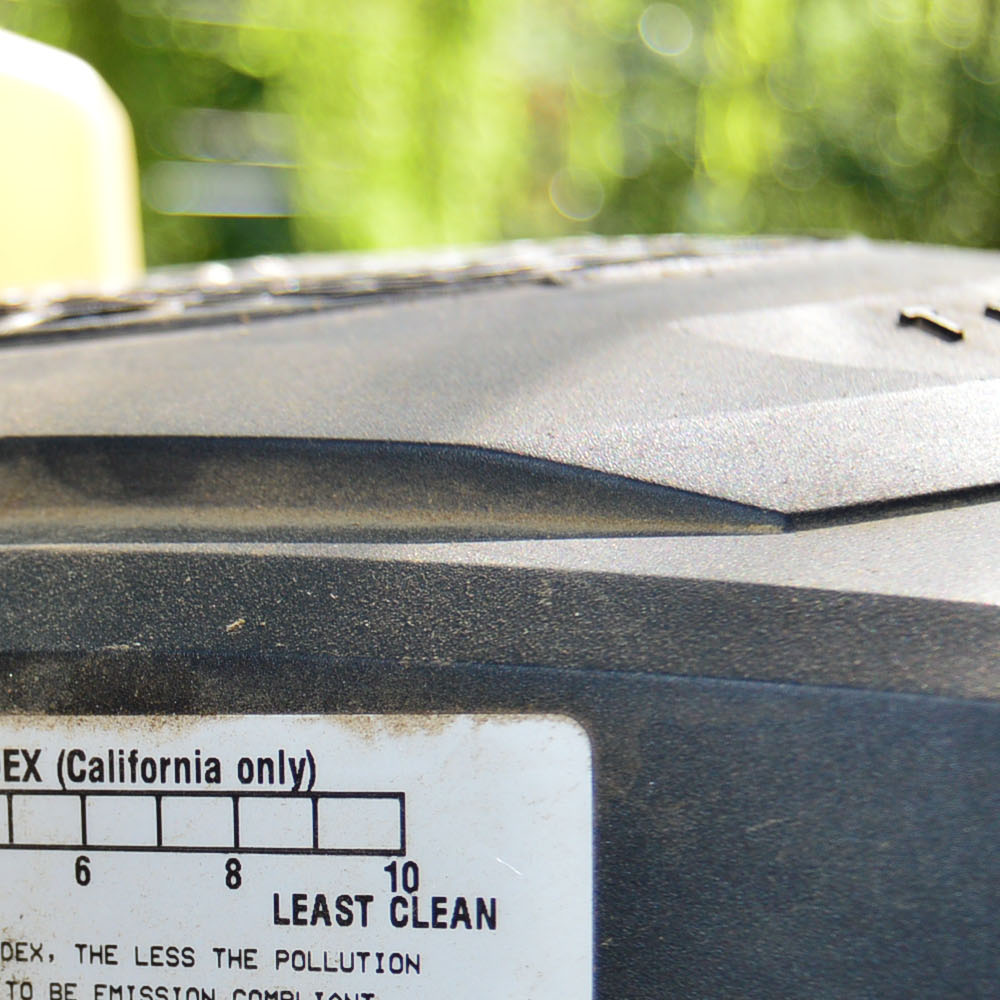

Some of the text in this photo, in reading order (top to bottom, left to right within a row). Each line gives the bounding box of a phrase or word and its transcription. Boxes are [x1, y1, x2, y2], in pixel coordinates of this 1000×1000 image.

[57, 749, 221, 789] (California
[237, 750, 318, 791] only)
[74, 855, 91, 887] 6
[224, 857, 242, 890] 8
[383, 860, 420, 895] 10
[273, 892, 497, 931] LEAST CLEAN
[74, 943, 119, 966] THE
[134, 945, 196, 968] LESS
[212, 947, 258, 970] THE
[275, 949, 421, 975] POLLUTION
